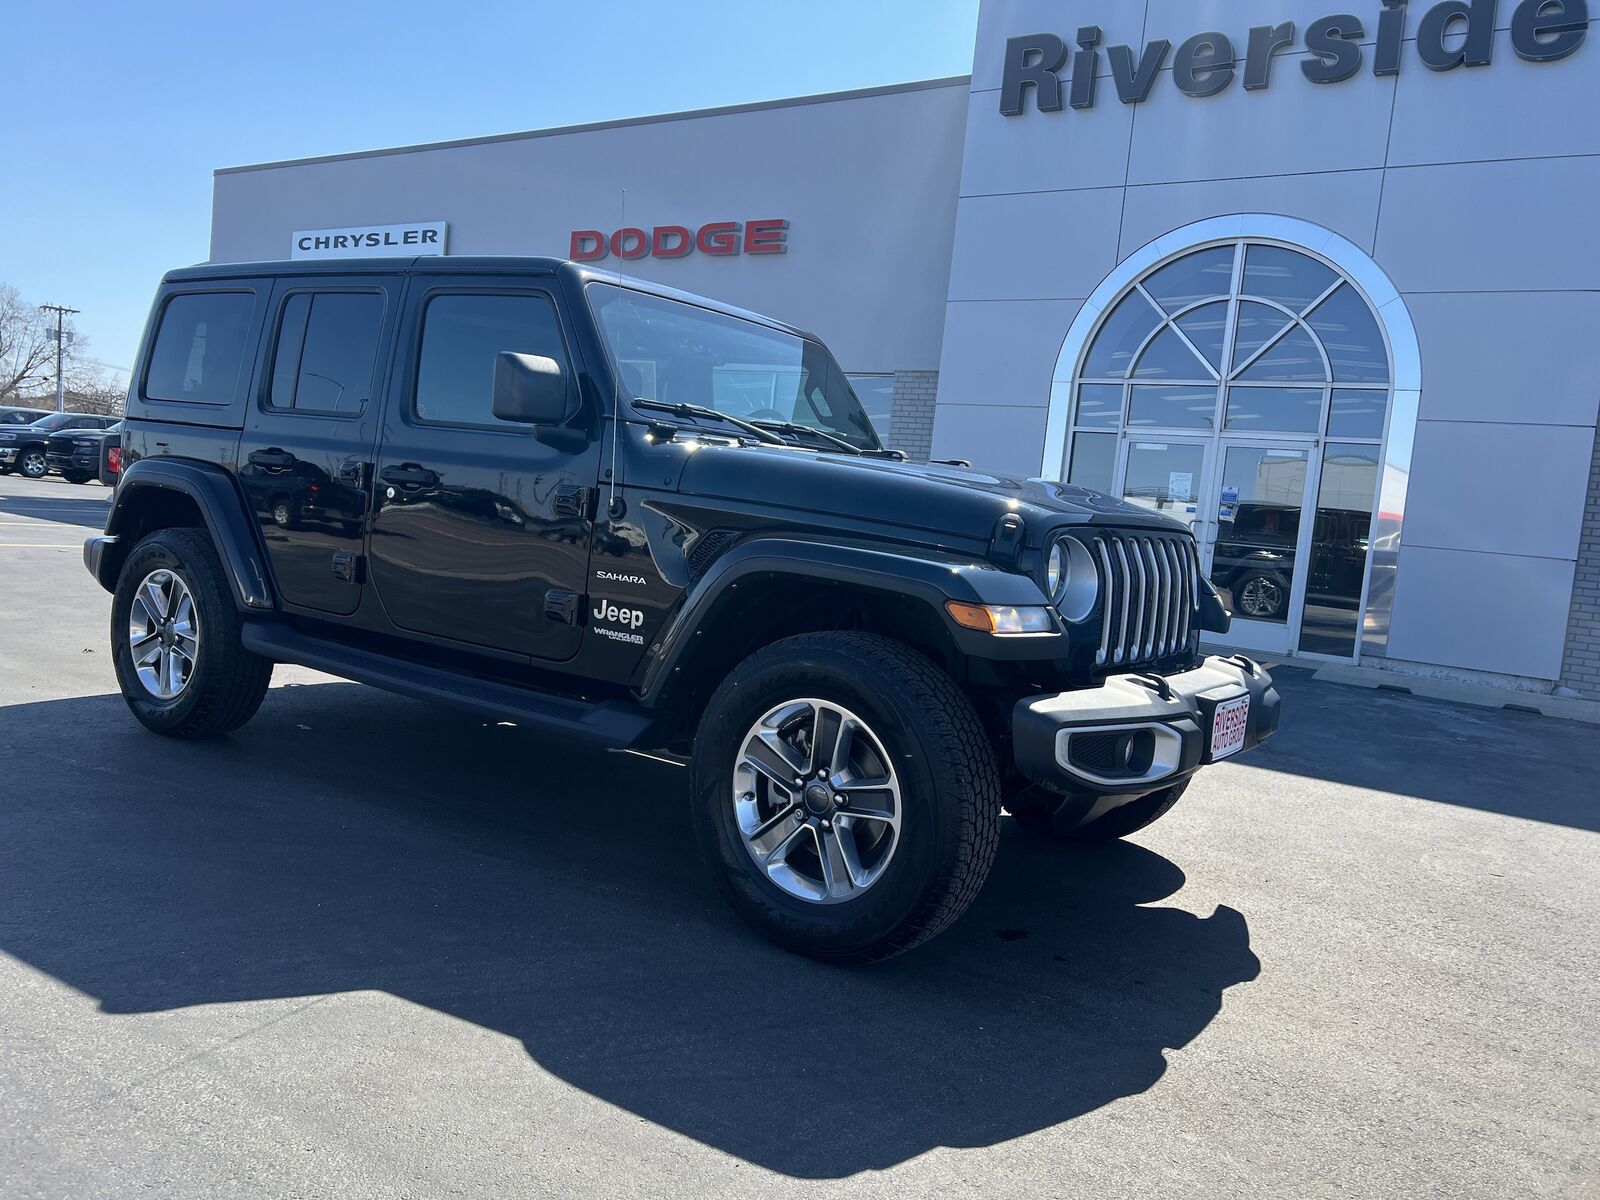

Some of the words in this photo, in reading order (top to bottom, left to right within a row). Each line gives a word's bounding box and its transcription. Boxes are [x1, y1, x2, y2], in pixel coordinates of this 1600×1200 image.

[999, 0, 1589, 116] Riverside
[298, 229, 438, 251] CHRYSLER
[570, 219, 789, 261] DODGE
[596, 570, 647, 585] SAHARA
[593, 599, 644, 630] Jeep
[593, 626, 644, 641] WRANGLER
[1214, 704, 1248, 734] RIVERSIDE
[1212, 731, 1228, 752] AUTO
